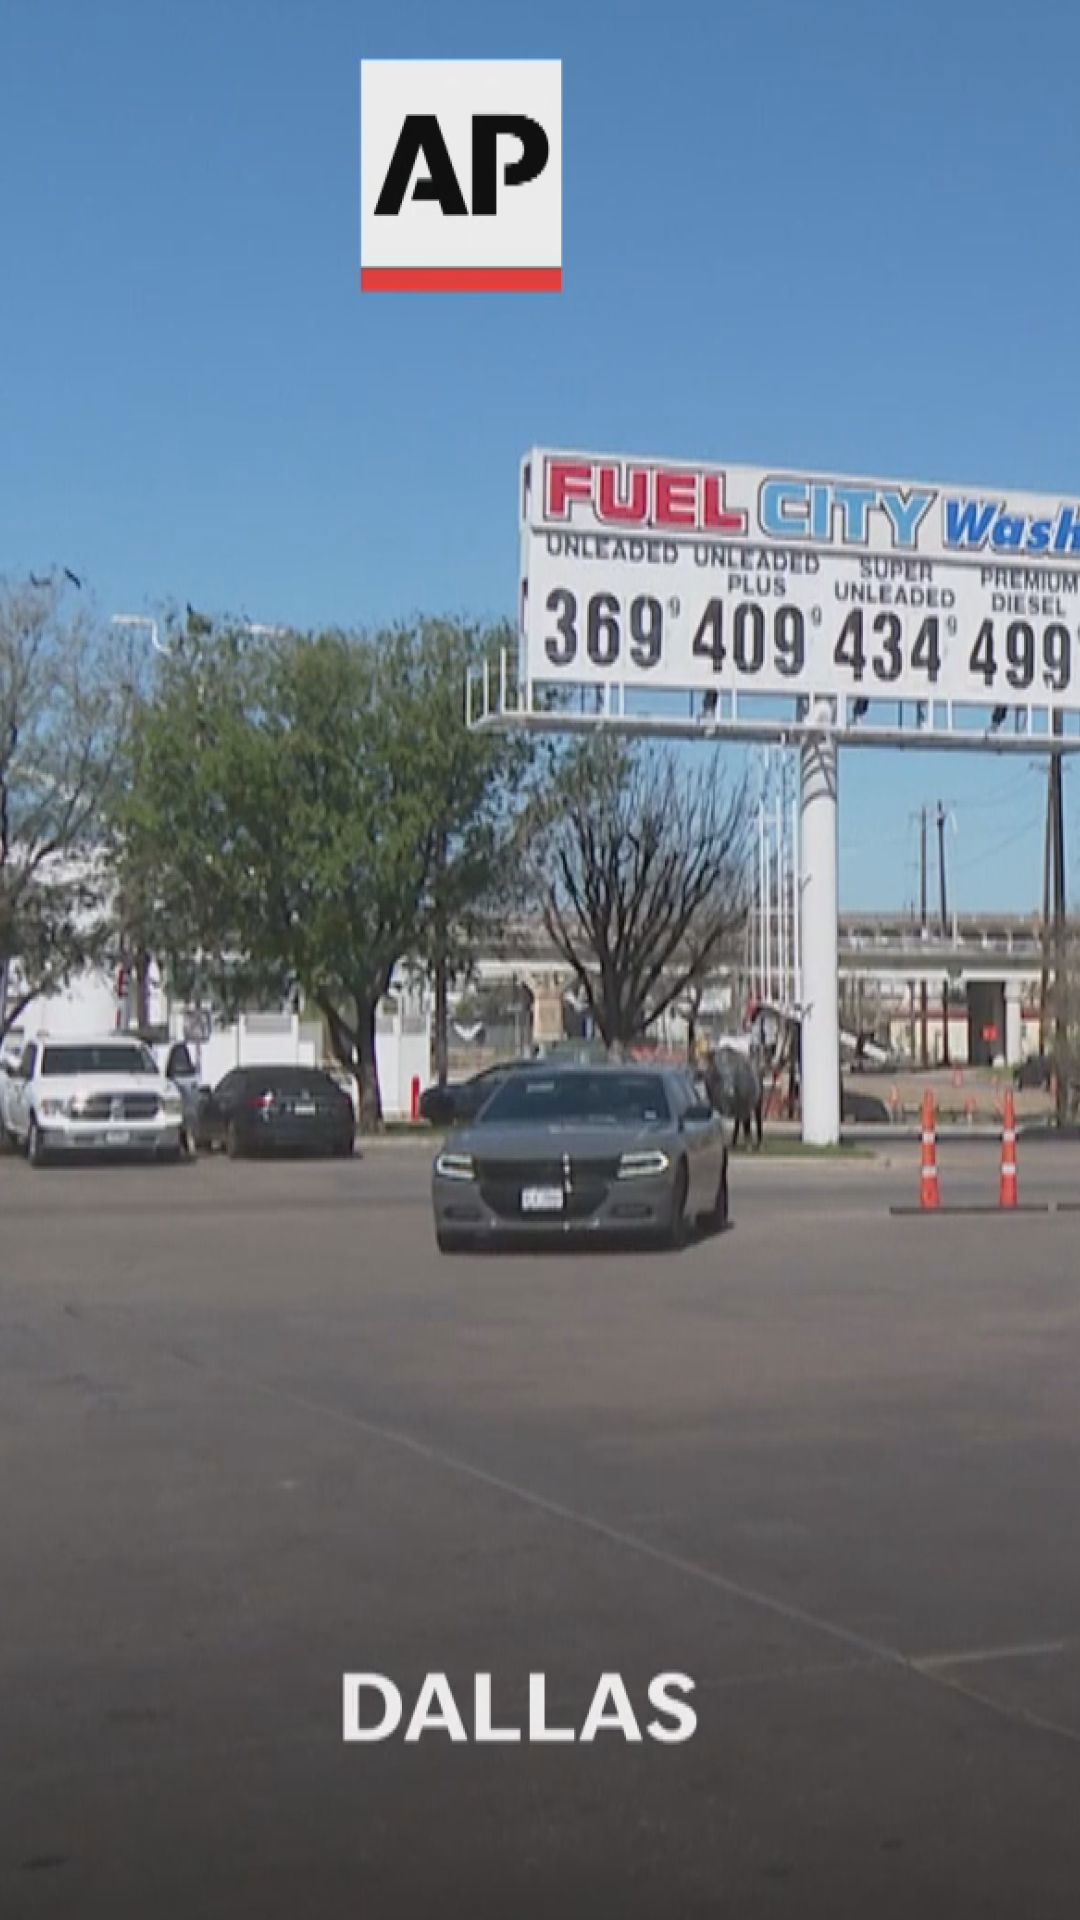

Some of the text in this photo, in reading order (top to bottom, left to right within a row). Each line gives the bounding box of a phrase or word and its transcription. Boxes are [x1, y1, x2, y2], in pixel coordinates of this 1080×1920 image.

[544, 457, 1080, 557] FUEL CITY Wash
[546, 534, 679, 564] UNLEADED
[694, 543, 820, 574] UNLEADED
[860, 555, 933, 582] SUPER
[981, 567, 1078, 593] PREMIUM
[728, 573, 786, 597] PLUS
[834, 581, 955, 608] UNLEADED
[992, 593, 1066, 617] DIESEL
